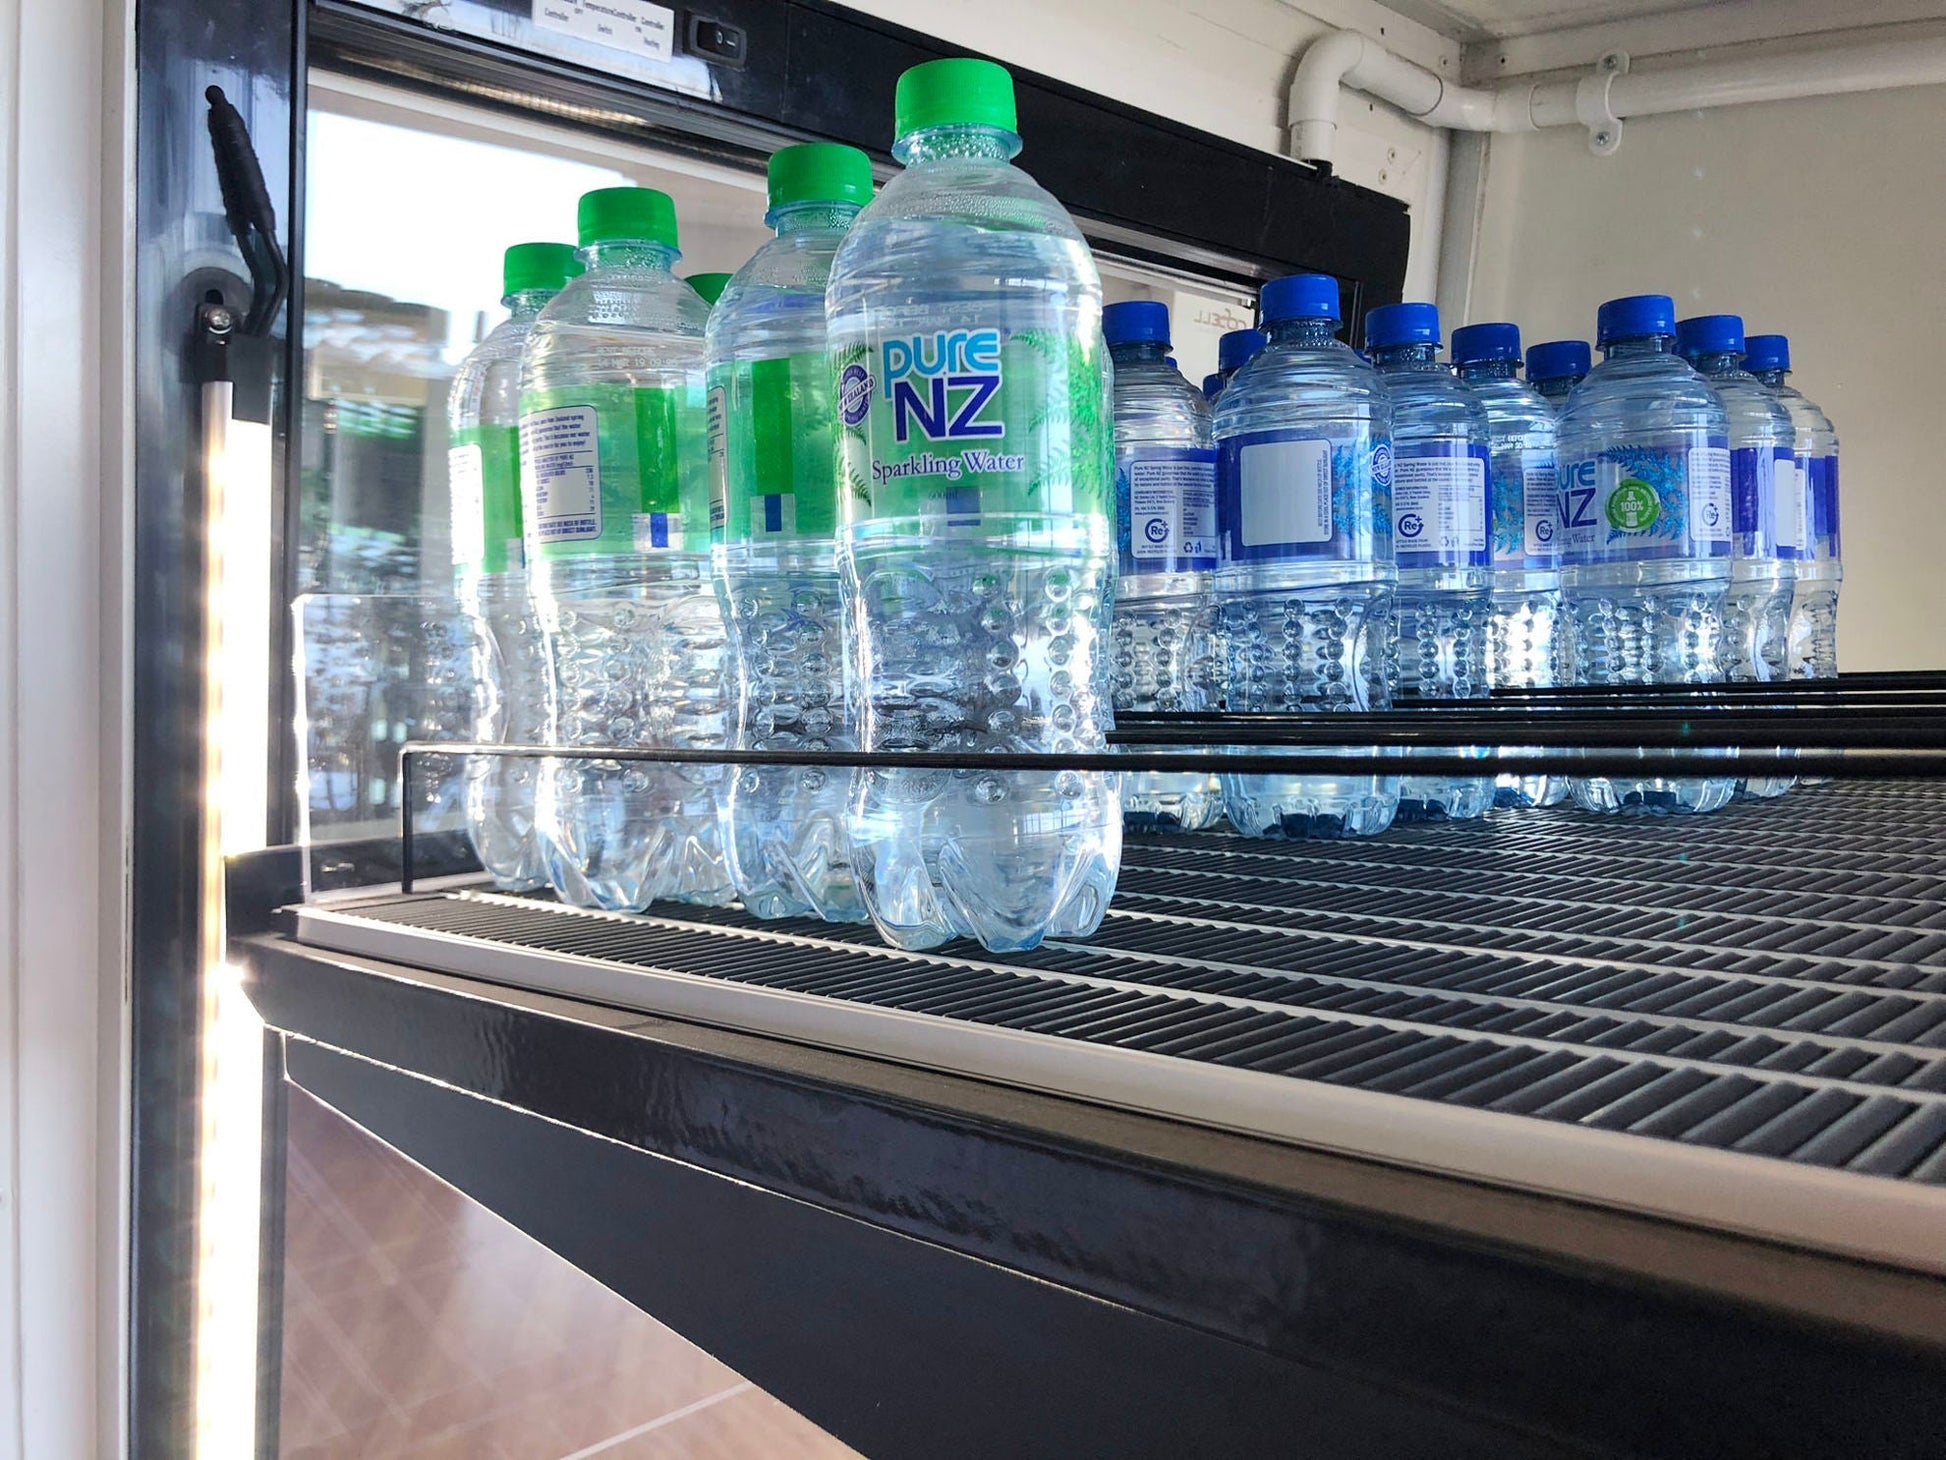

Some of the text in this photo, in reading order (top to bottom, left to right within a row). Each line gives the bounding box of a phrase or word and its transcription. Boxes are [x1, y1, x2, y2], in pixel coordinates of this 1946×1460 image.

[895, 376, 1002, 441] NZ
[873, 451, 1024, 483] Sparkling Water
[1556, 488, 1597, 528] NZ
[1620, 500, 1644, 512] 100%
